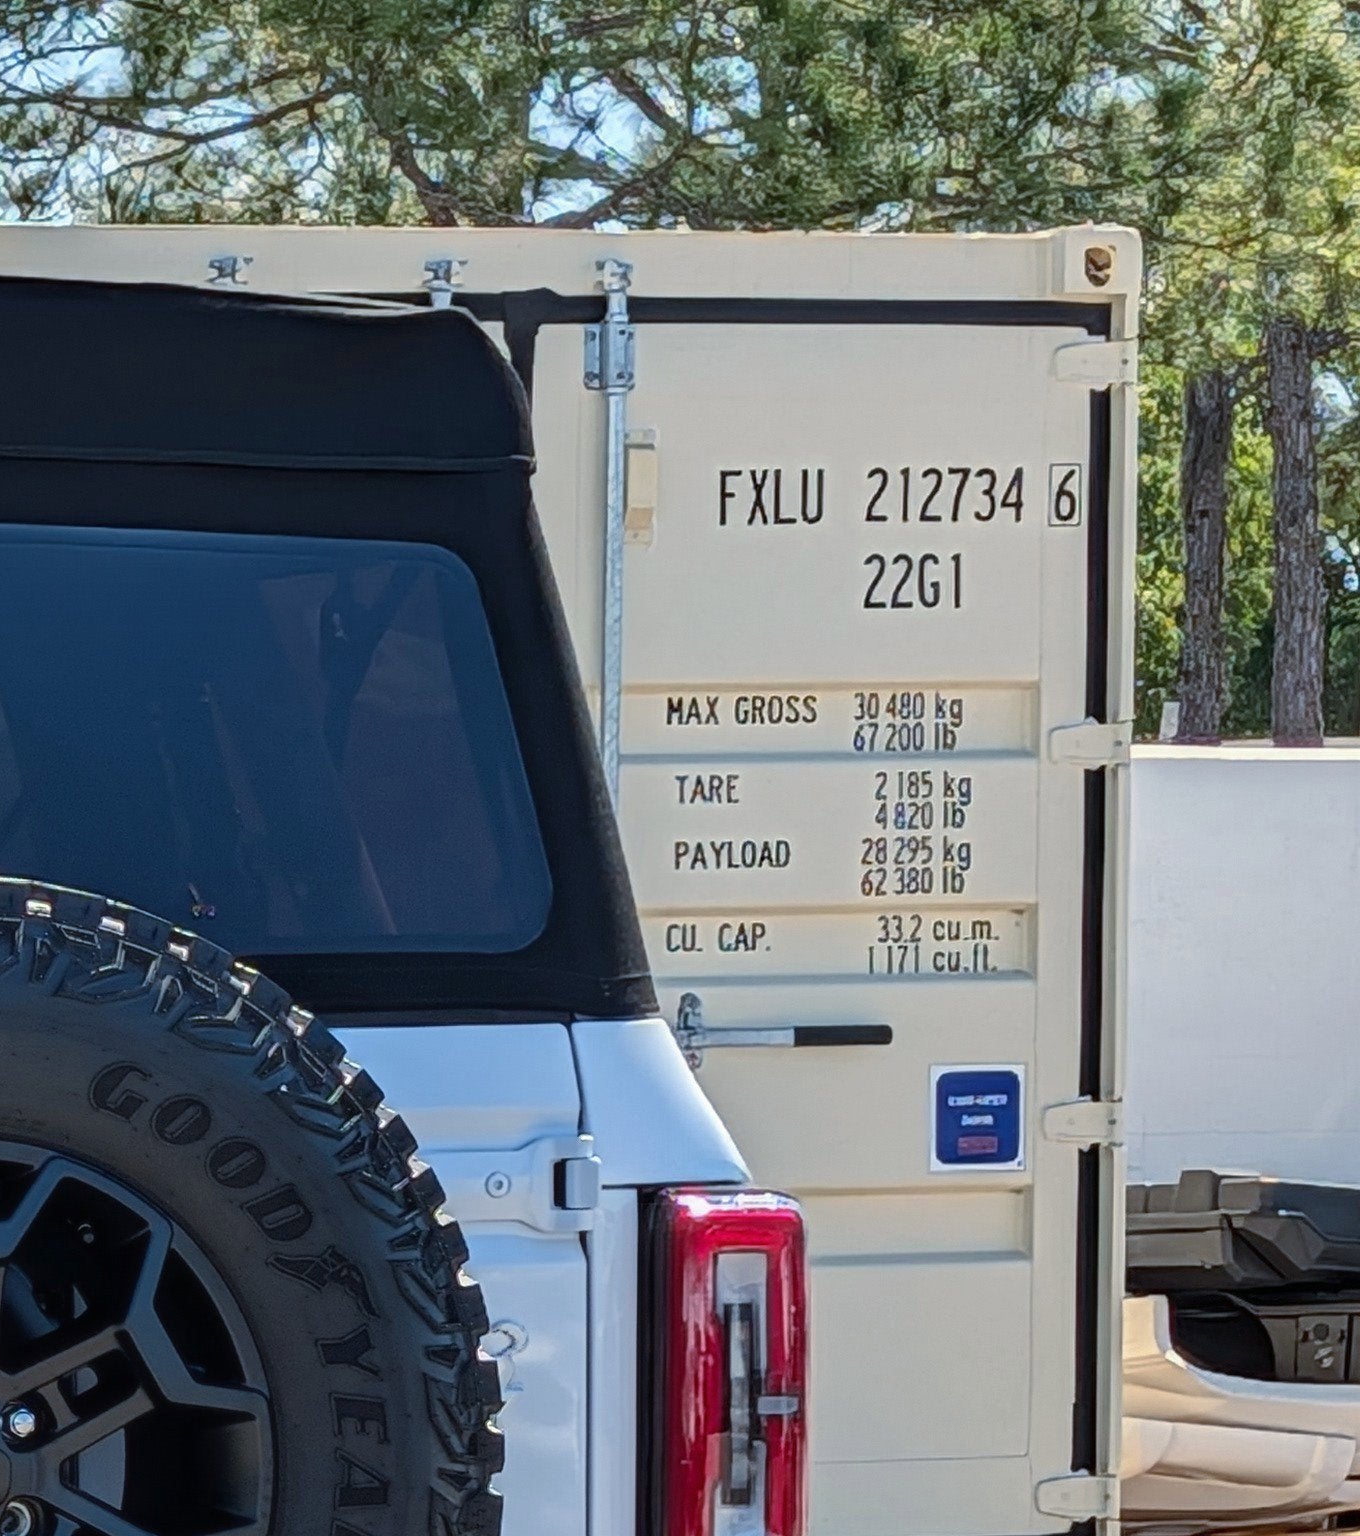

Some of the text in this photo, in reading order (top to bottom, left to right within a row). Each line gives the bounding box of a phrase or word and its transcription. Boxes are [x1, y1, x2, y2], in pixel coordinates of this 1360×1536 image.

[718, 467, 1078, 526] FXLU 212734 6
[863, 552, 963, 609] 22G1
[666, 695, 720, 726] MAX
[734, 694, 819, 726] GROSS
[934, 690, 964, 728] kg
[934, 722, 958, 751] lb
[674, 774, 741, 804] TARE
[942, 769, 973, 806] kg
[942, 801, 967, 830] lb
[674, 840, 792, 870] PAYLOAD
[942, 834, 973, 871] kg
[942, 866, 966, 895] lb
[665, 923, 704, 953] CU.
[718, 921, 772, 953] CAP.
